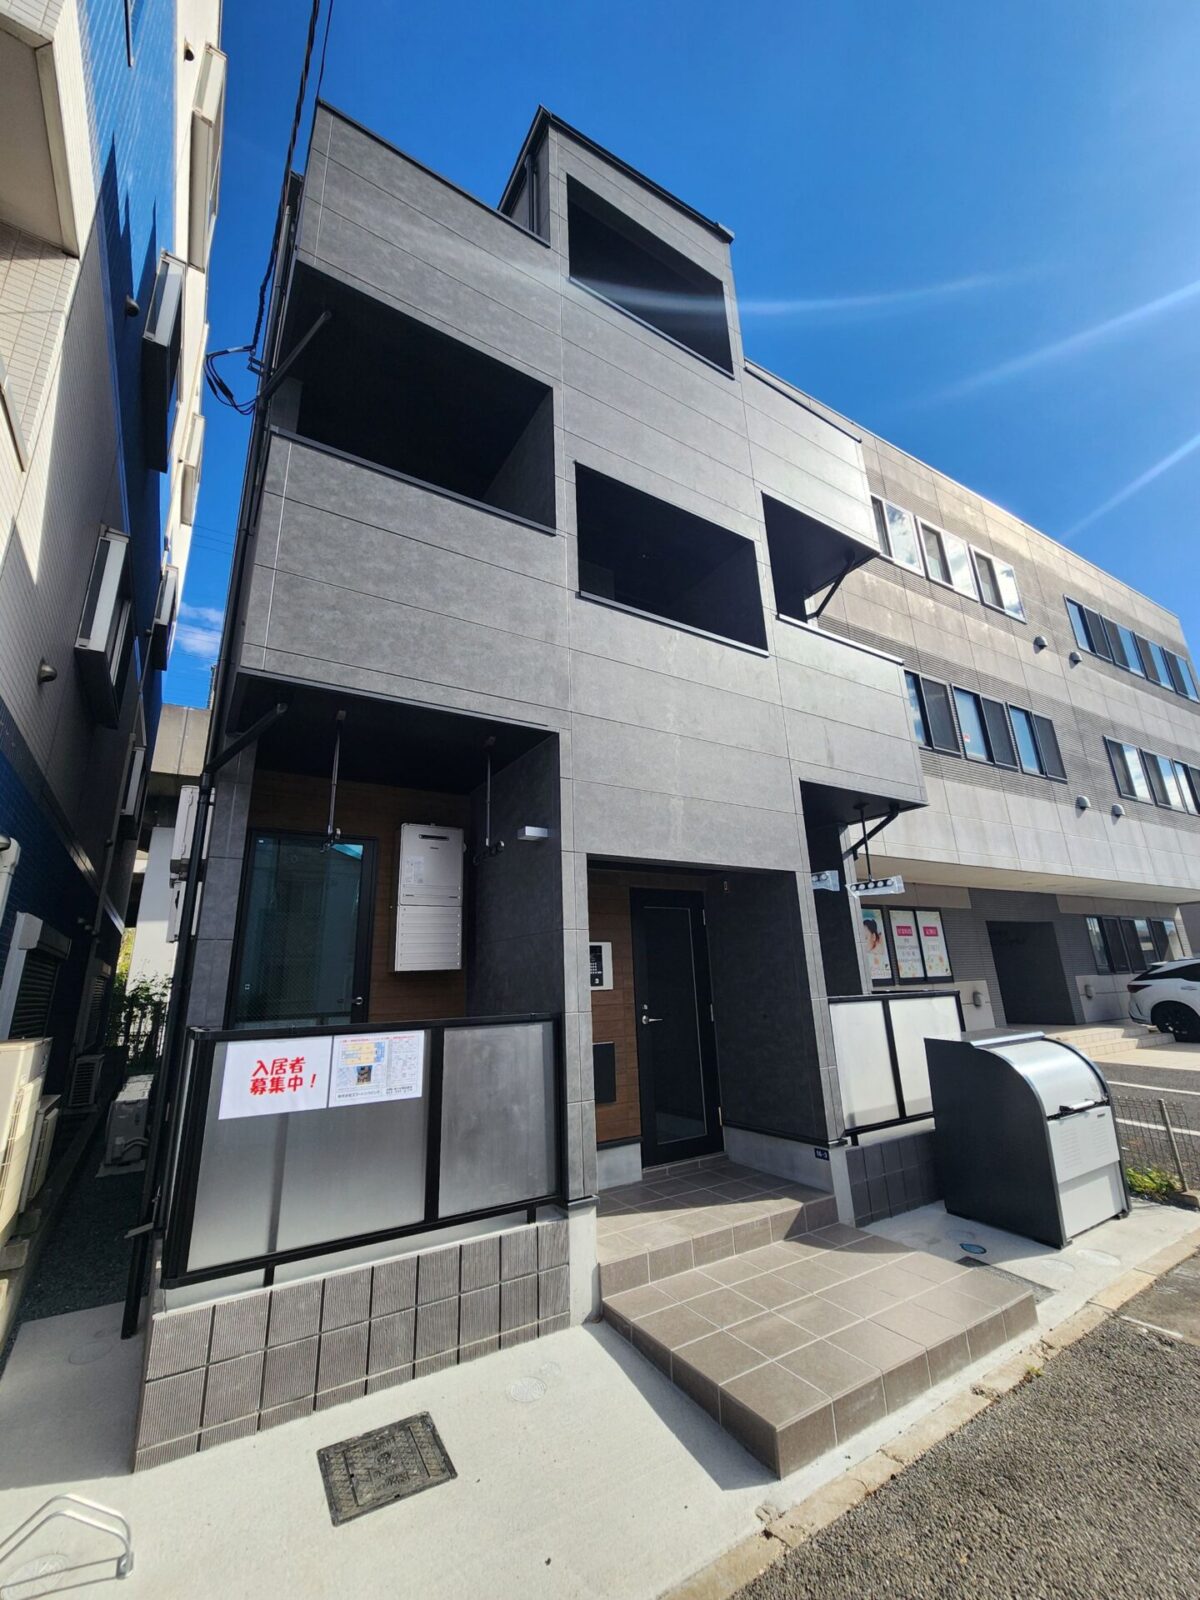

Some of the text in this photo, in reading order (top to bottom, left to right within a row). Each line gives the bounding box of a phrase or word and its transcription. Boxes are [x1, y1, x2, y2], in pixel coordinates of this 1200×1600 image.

[252, 1057, 306, 1077] 入居者
[250, 1074, 317, 1097] 募集中！
